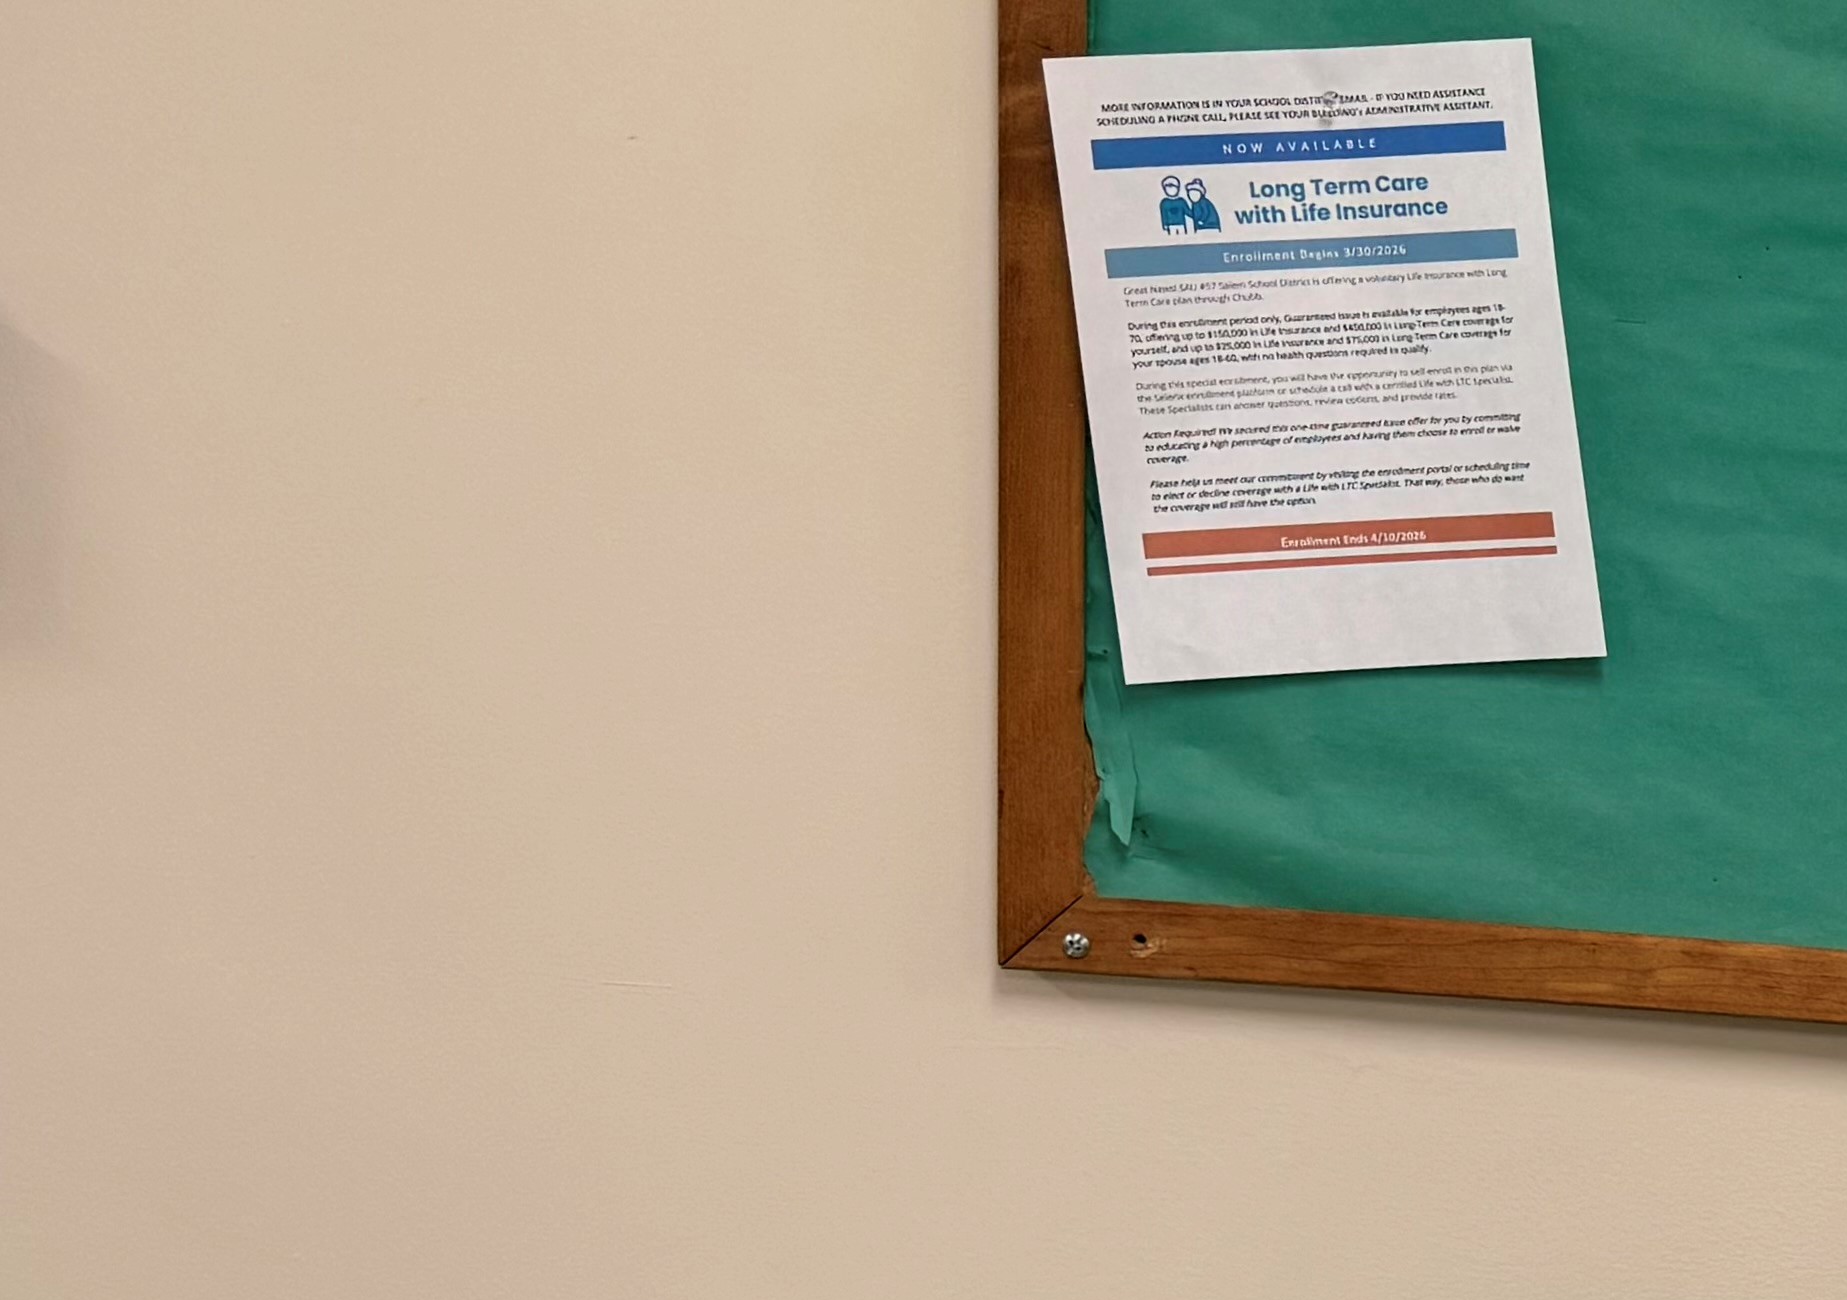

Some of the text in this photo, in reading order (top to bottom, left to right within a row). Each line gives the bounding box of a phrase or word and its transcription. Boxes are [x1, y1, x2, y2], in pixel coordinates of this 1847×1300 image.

[1131, 101, 1200, 111] INFORMATION
[1225, 99, 1250, 108] YOUR
[1254, 97, 1291, 107] SCHOOL
[1432, 87, 1486, 99] ASSISTANCE
[1096, 115, 1157, 126] SCHEDULING
[1229, 111, 1262, 120] PLEASE
[1282, 109, 1310, 119] YOUR
[1222, 138, 1377, 154] NOW AVAILABLE
[1249, 176, 1429, 202] Long Term Care
[1235, 200, 1448, 225] with Life Insurance
[1222, 250, 1296, 263] Enrollment
[1343, 243, 1407, 257] 3/30/2026
[1281, 536, 1341, 548] Enrollment
[1343, 533, 1369, 545] Ends
